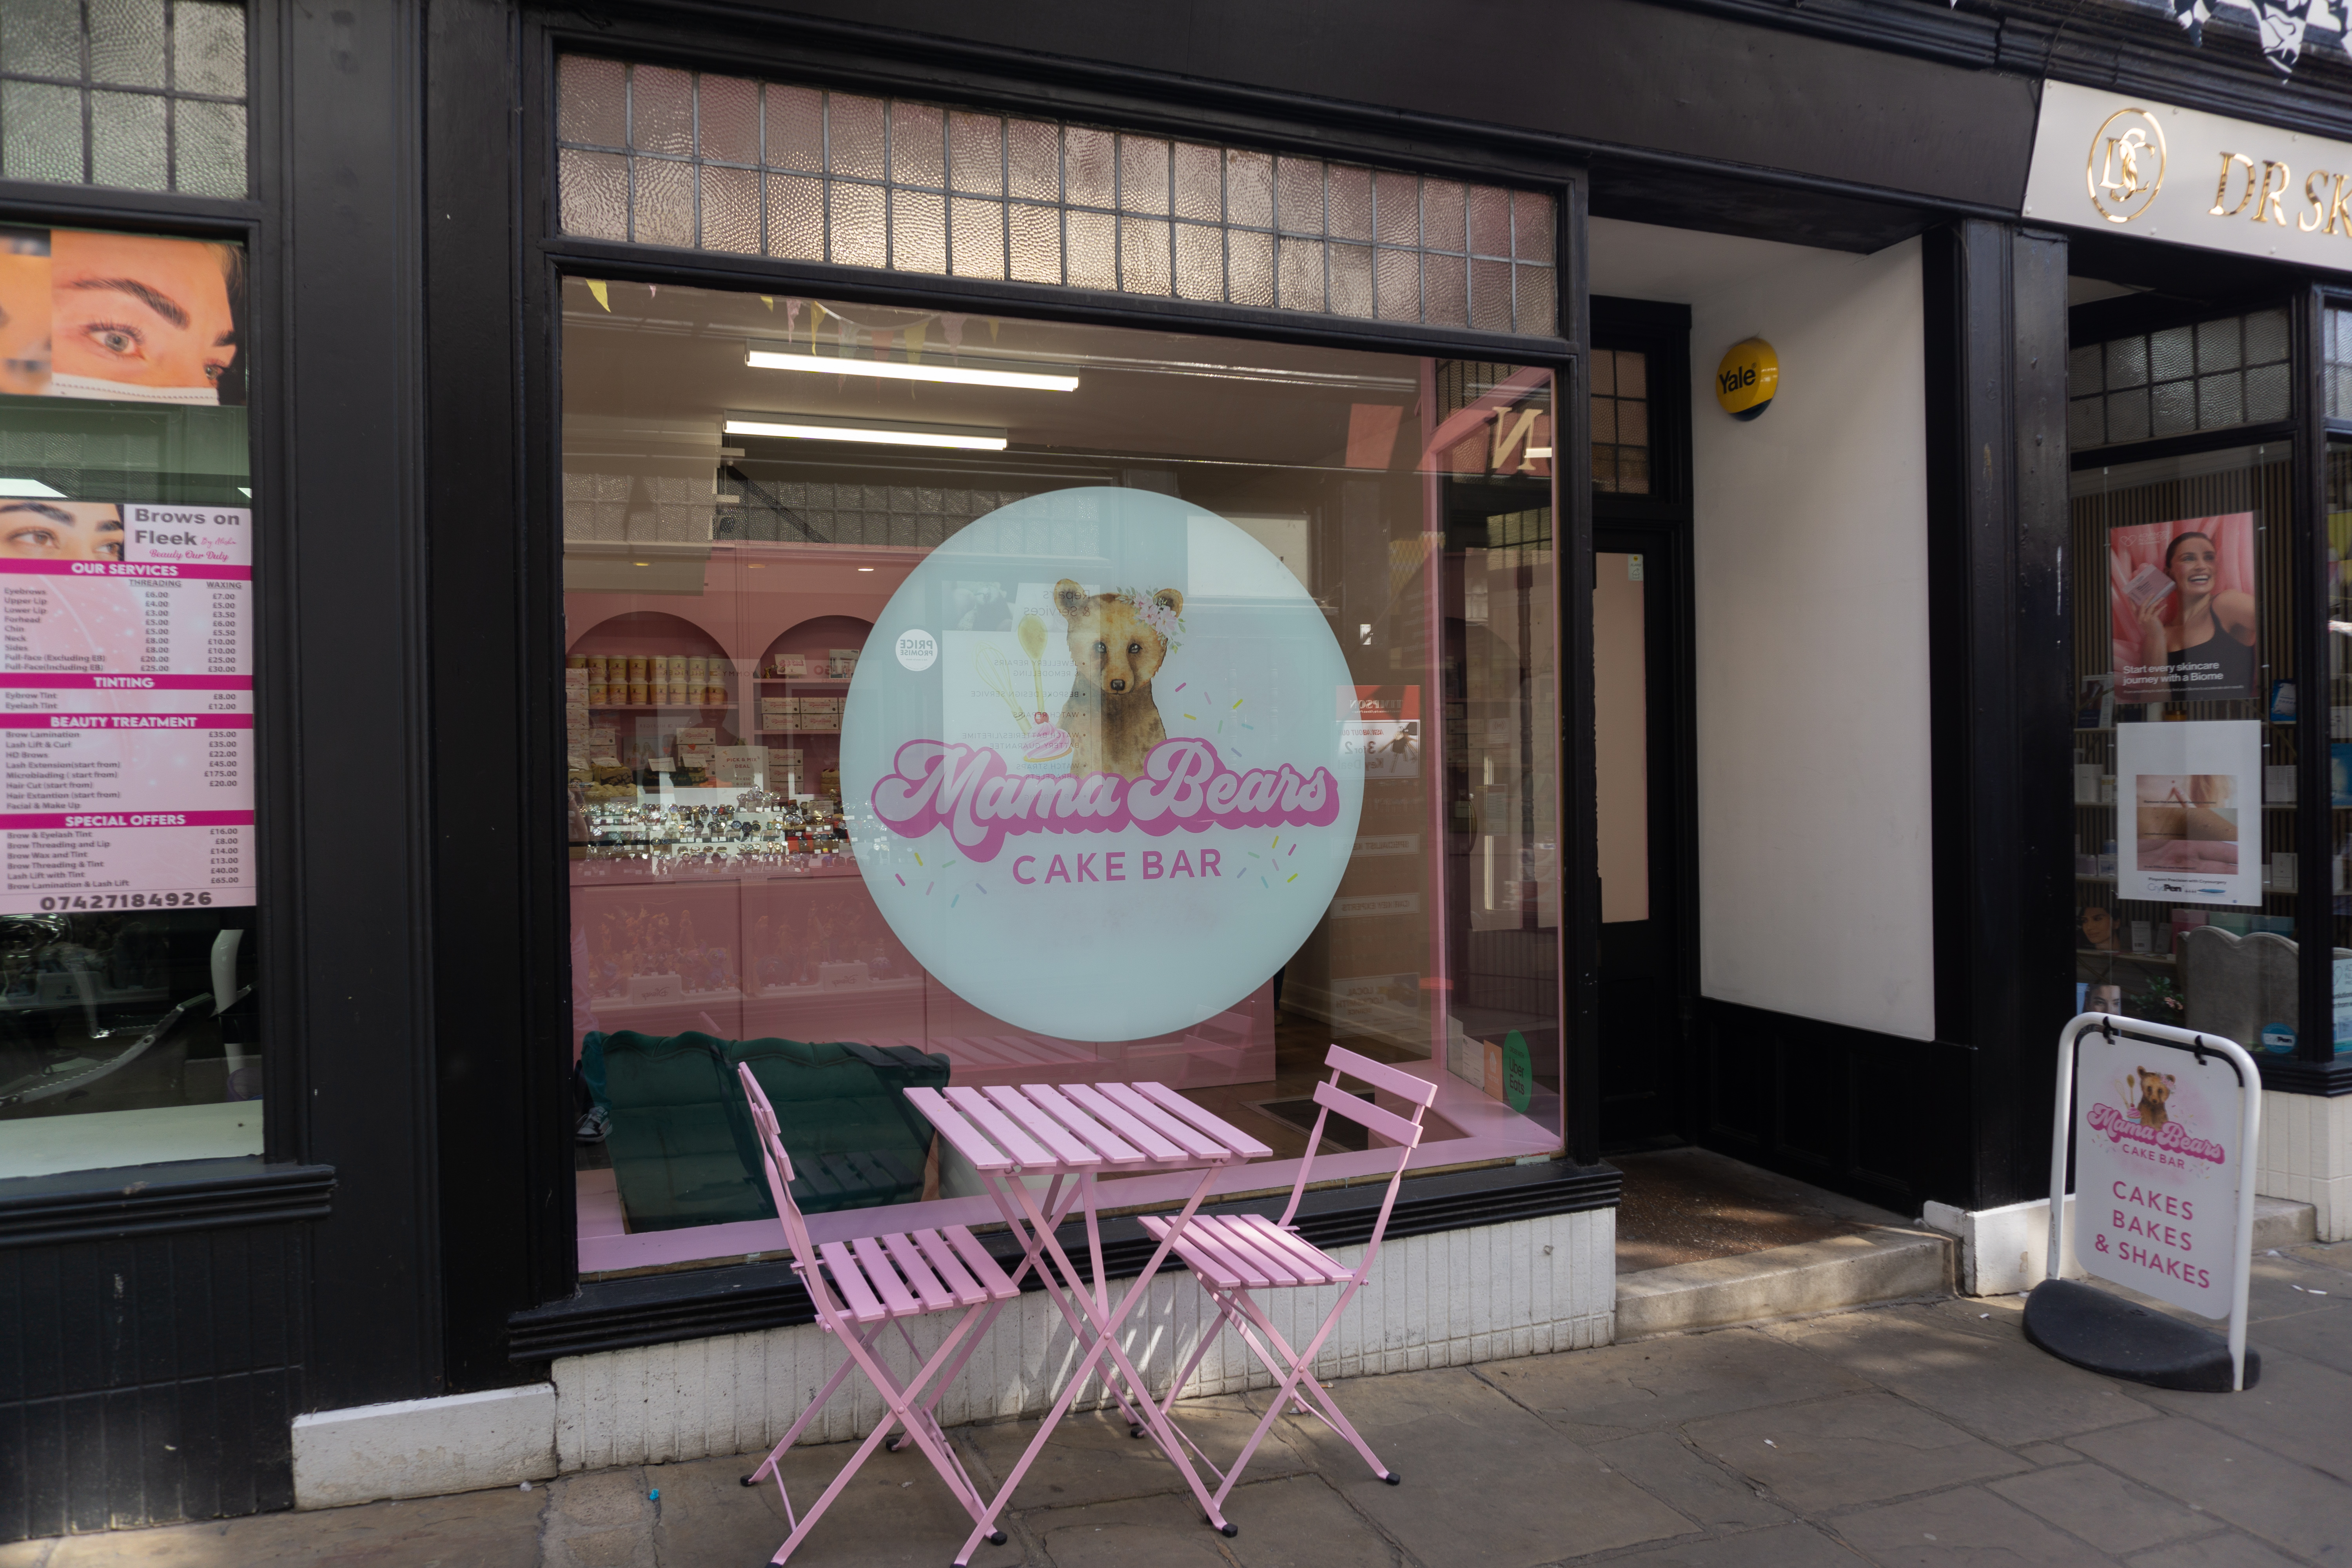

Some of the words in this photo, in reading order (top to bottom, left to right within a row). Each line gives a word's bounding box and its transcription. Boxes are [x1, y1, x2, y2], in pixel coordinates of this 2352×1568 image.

[2208, 151, 2290, 226] DR
[2298, 169, 2352, 238] SK
[1719, 366, 1756, 394] Yale
[135, 508, 205, 524] Brows
[214, 514, 240, 525] on
[135, 530, 197, 545] Fleek
[149, 549, 182, 560] Beauty
[185, 550, 204, 559] Our
[206, 550, 229, 562] Duty
[71, 563, 106, 574] OUR
[109, 564, 179, 576] SERVICES
[2123, 665, 2147, 674] Start
[2177, 662, 2220, 671] skincare
[94, 677, 155, 688] TINTING
[2123, 677, 2158, 686] journey
[2160, 674, 2181, 682] with
[2191, 672, 2224, 681] Biome
[51, 716, 109, 727] BEAUTY
[111, 716, 198, 727] TREATMENT
[870, 739, 1131, 863] Mama
[1127, 737, 1339, 837] Bears
[65, 815, 128, 827] SPECIAL
[130, 815, 186, 826] OFFERS
[1012, 851, 1126, 885] CAKE
[1142, 848, 1222, 880] BAR
[40, 892, 212, 910] 07427184926
[1509, 1057, 1524, 1078] Uber
[1510, 1073, 1524, 1095] Eats
[2087, 1103, 2157, 1145] Mama
[2156, 1121, 2225, 1165] Bears
[2123, 1143, 2156, 1161] CAKE
[2159, 1154, 2185, 1170] BAR
[2112, 1180, 2193, 1221] CAKES
[2113, 1209, 2192, 1251] BAKES
[2095, 1234, 2109, 1254] &
[2119, 1242, 2210, 1289] SHAKES
